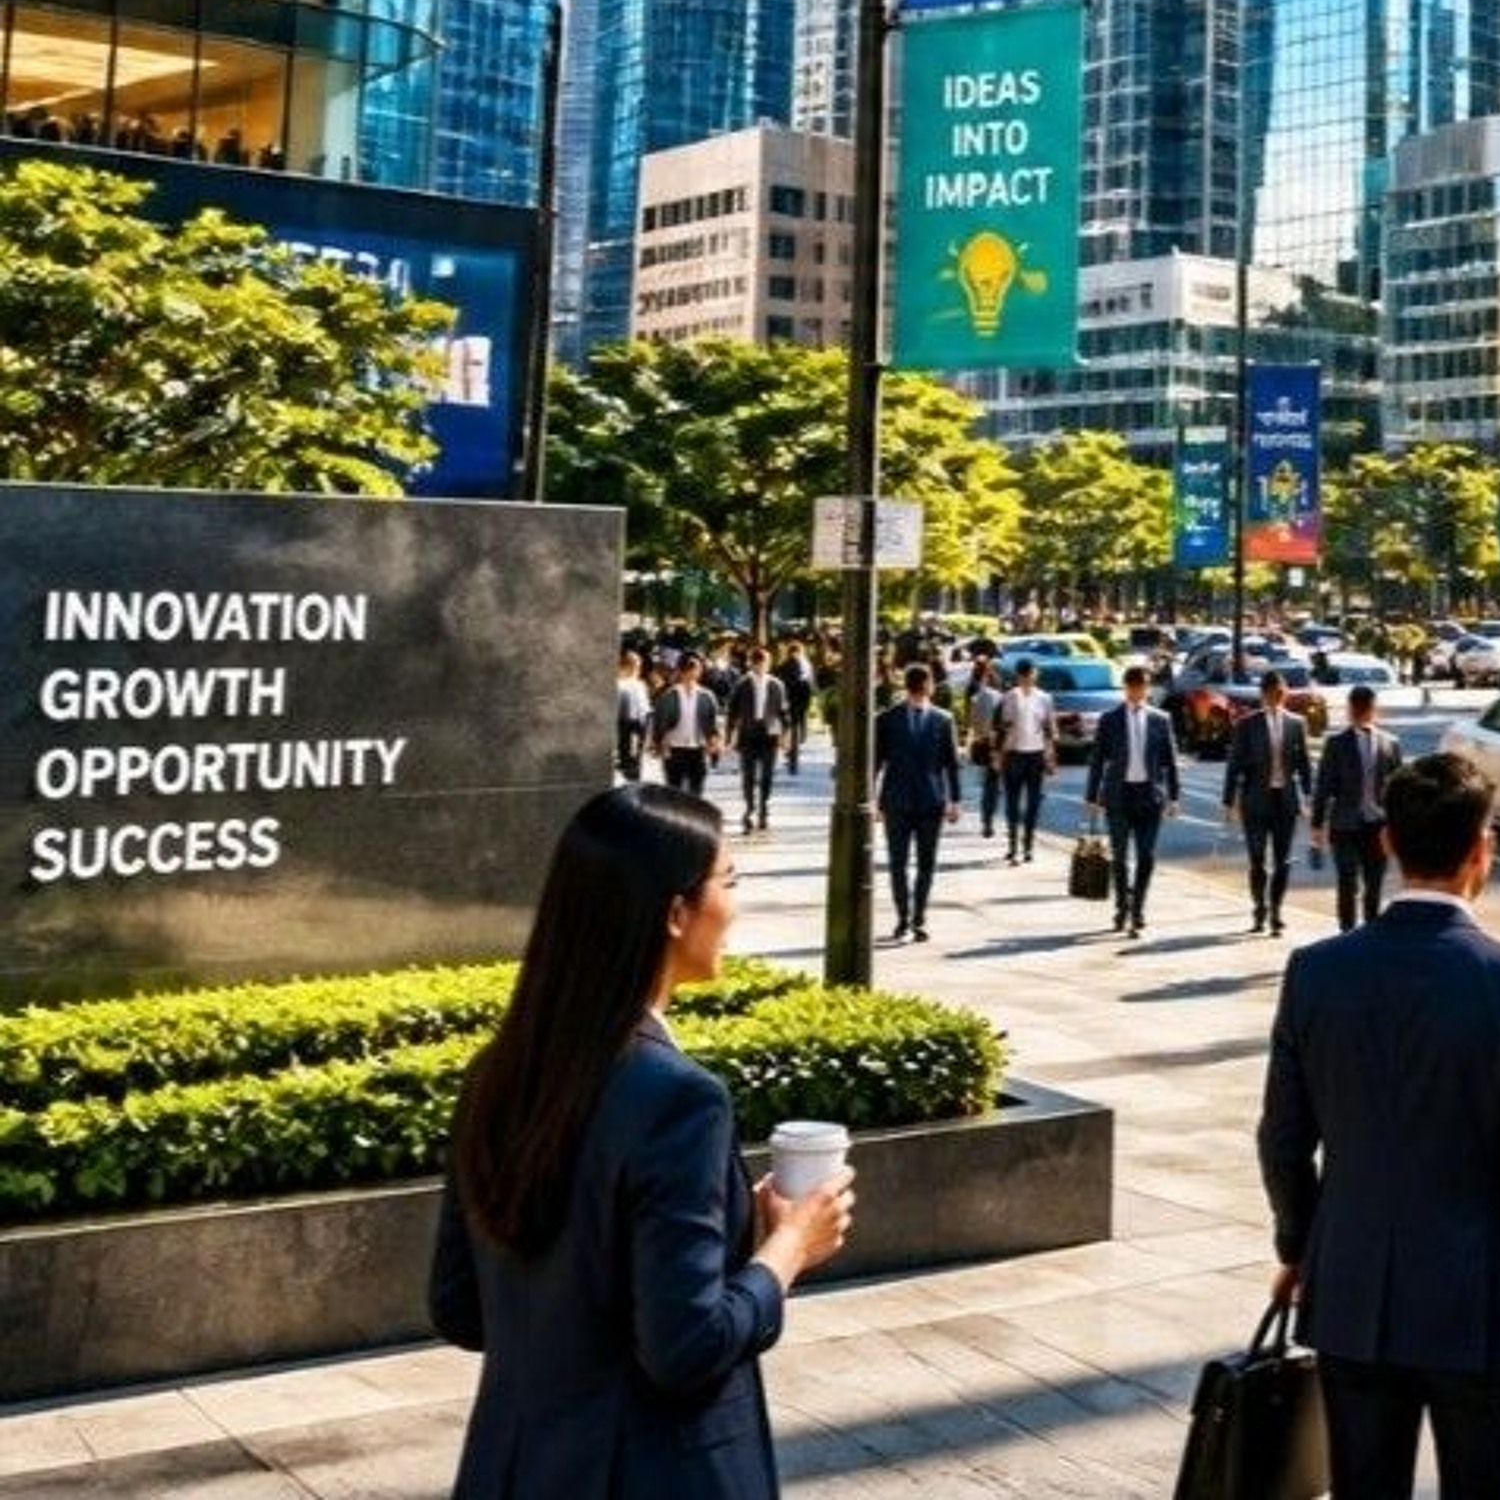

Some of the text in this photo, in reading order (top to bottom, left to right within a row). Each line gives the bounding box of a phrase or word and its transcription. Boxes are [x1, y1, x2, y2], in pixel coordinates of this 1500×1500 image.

[943, 70, 1042, 109] IDEAS
[953, 119, 1029, 157] INTO
[925, 167, 1053, 209] IMPACT
[44, 590, 368, 641] INNOVATION
[40, 667, 286, 720] GROWTH
[35, 737, 407, 799] OPPORTUNITY
[30, 817, 281, 882] SUCCESS
